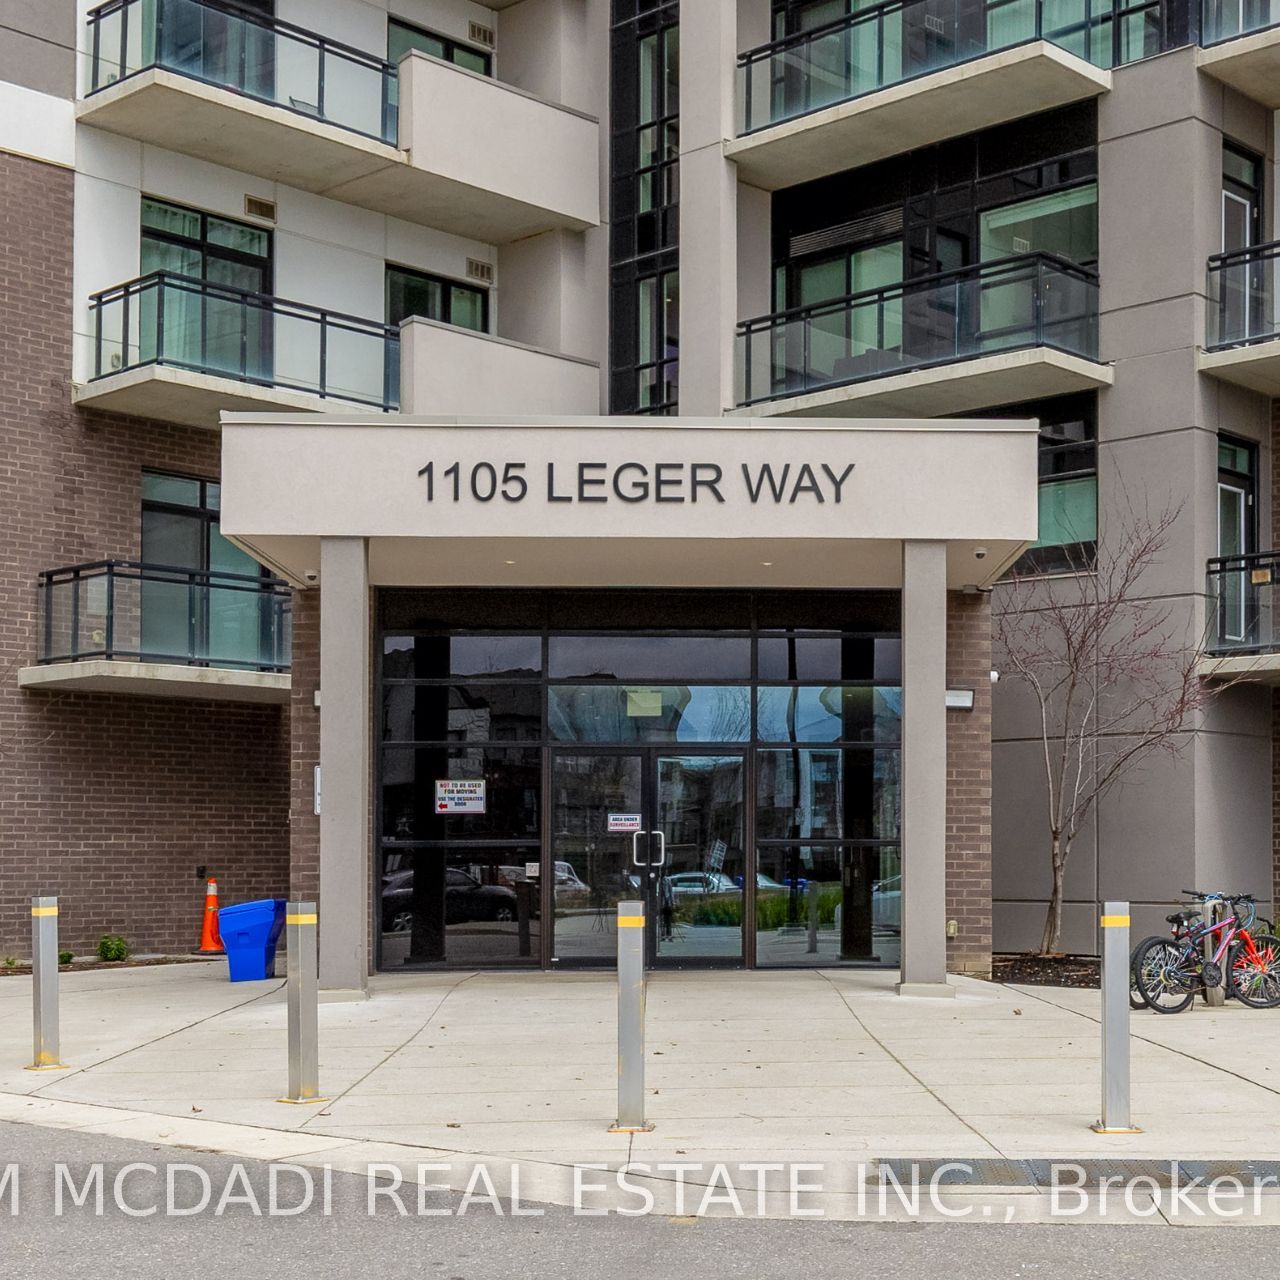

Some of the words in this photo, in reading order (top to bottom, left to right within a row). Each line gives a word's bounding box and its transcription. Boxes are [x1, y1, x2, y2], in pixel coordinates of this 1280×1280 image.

[417, 461, 528, 504] 1105
[547, 461, 726, 505] LEGER
[740, 463, 856, 505] WAY
